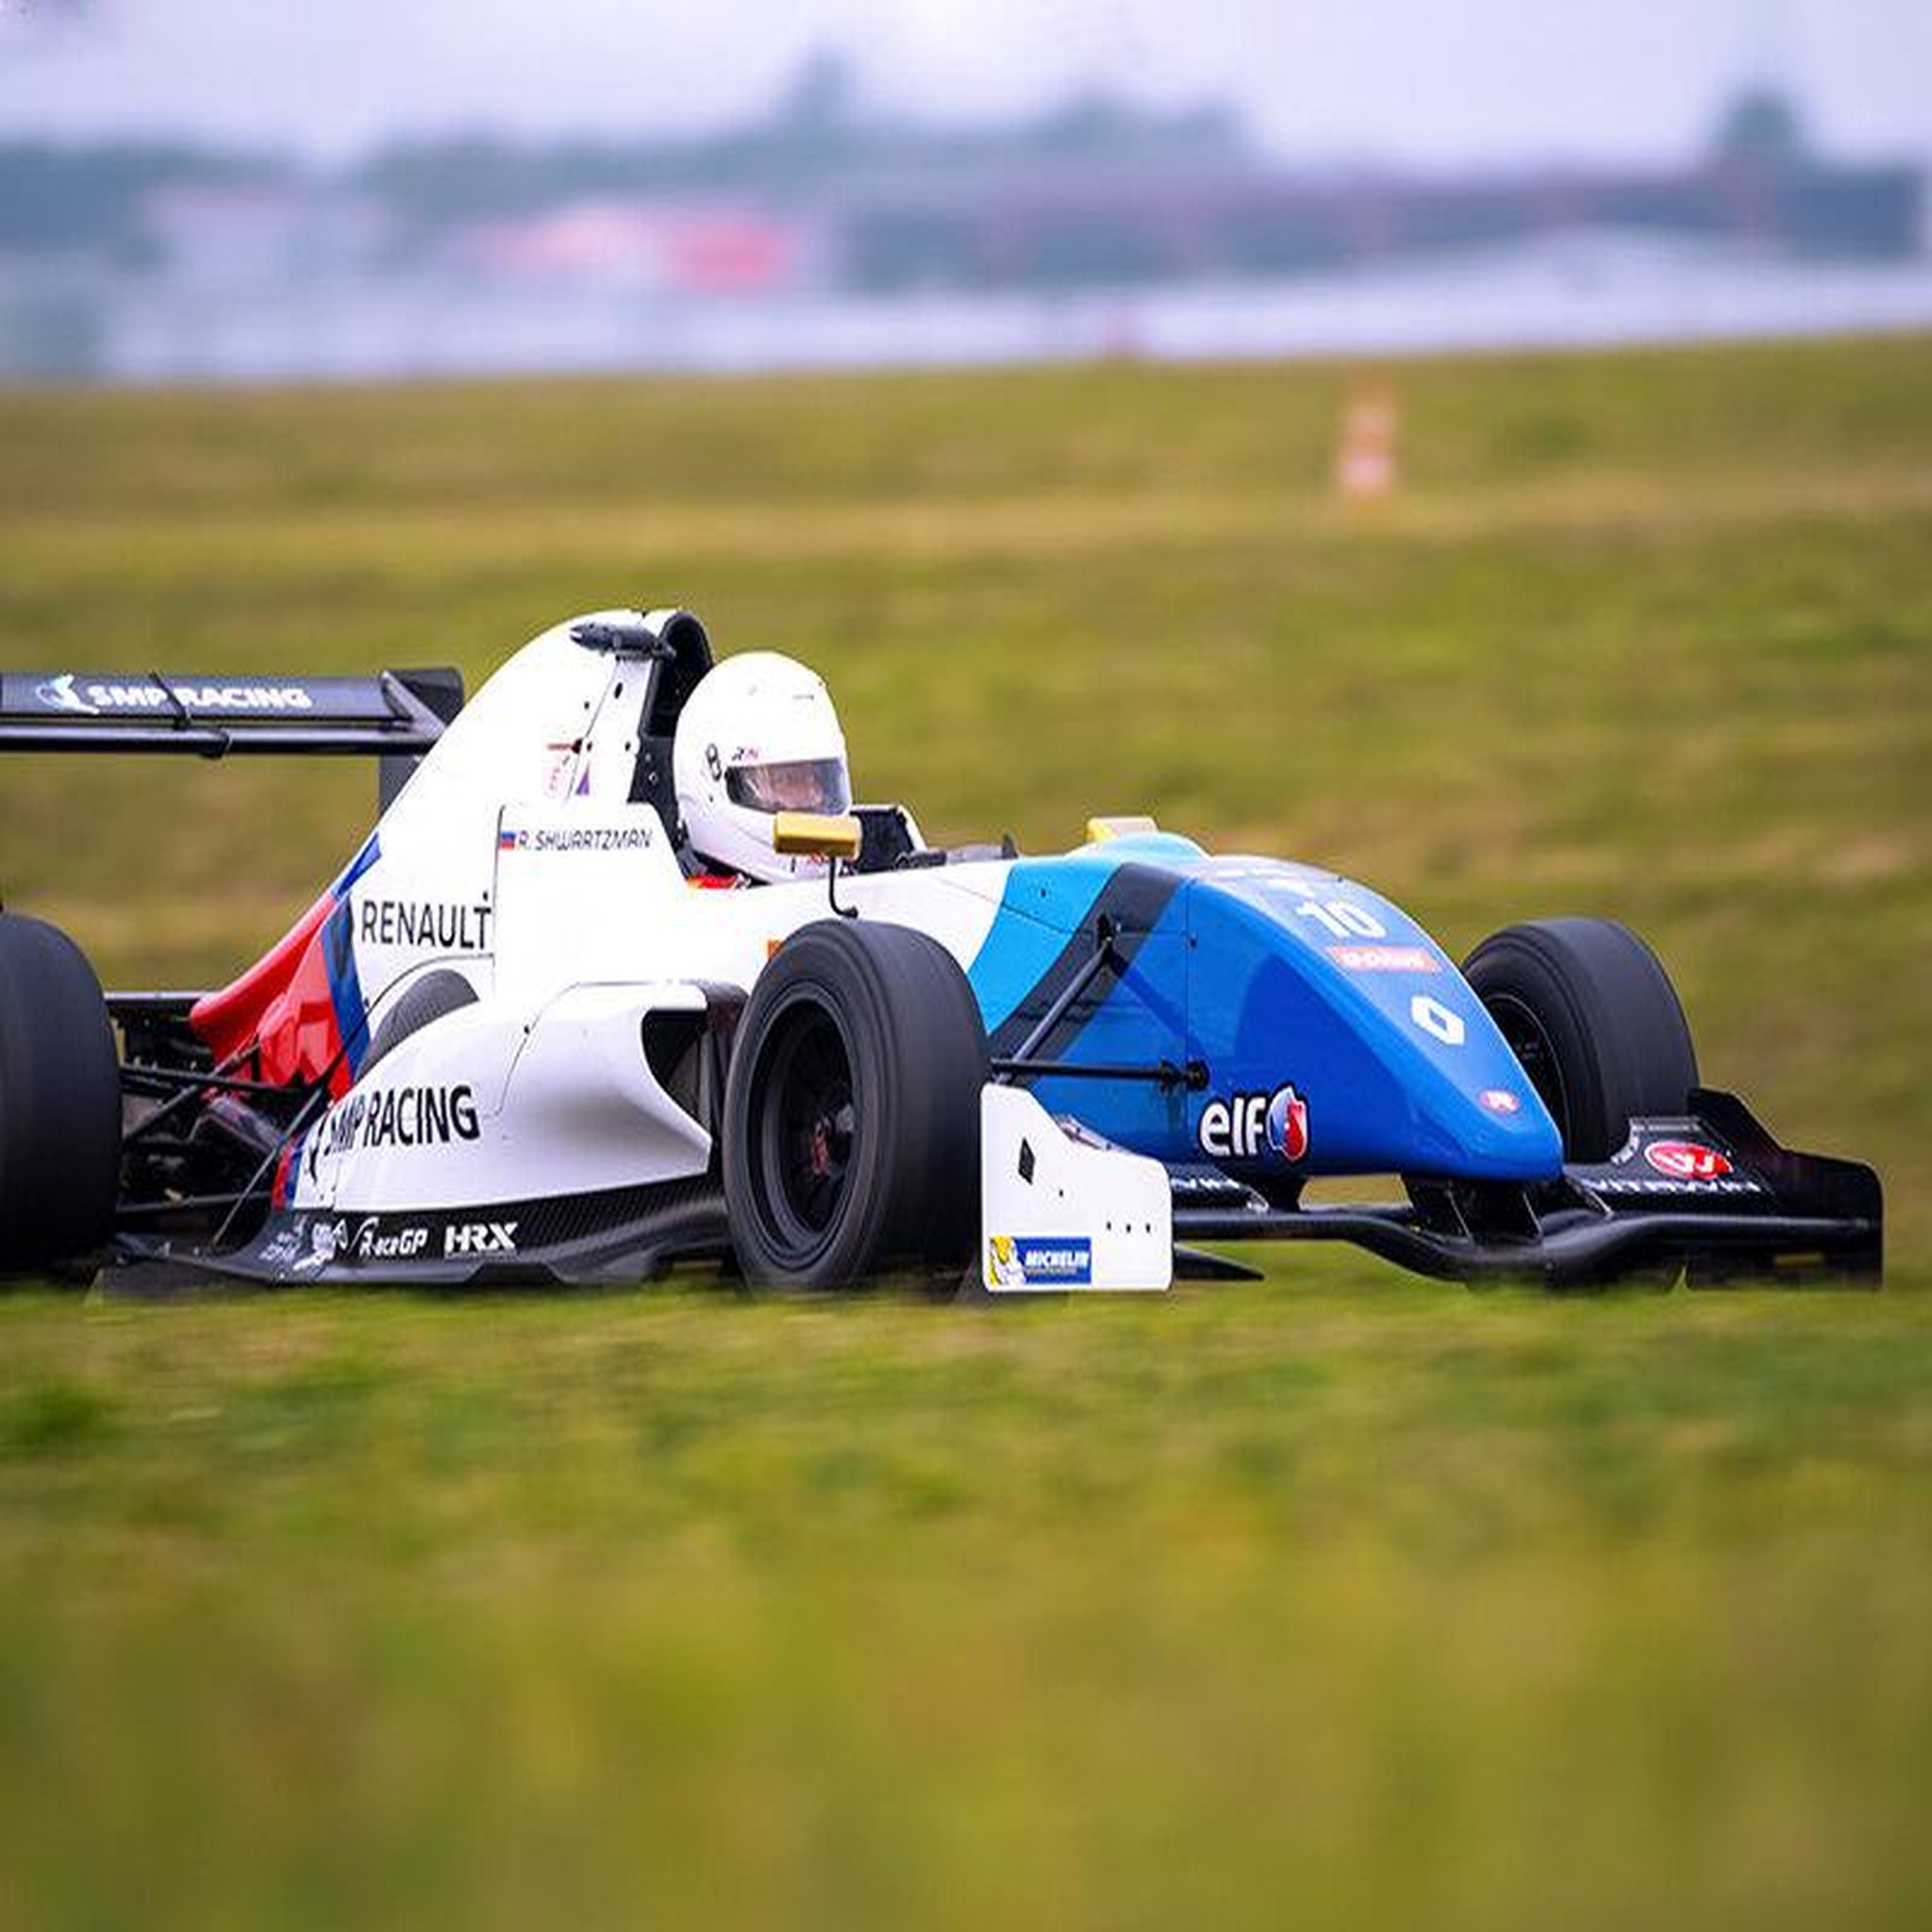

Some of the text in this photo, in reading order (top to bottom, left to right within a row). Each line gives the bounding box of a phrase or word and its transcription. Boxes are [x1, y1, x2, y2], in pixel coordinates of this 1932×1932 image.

[88, 686, 312, 708] SMP RACING
[361, 899, 491, 950] RENAULT
[1294, 899, 1388, 941] 10
[362, 1084, 481, 1148] RACING
[1199, 1096, 1267, 1158] elf
[443, 1222, 518, 1253] HRX
